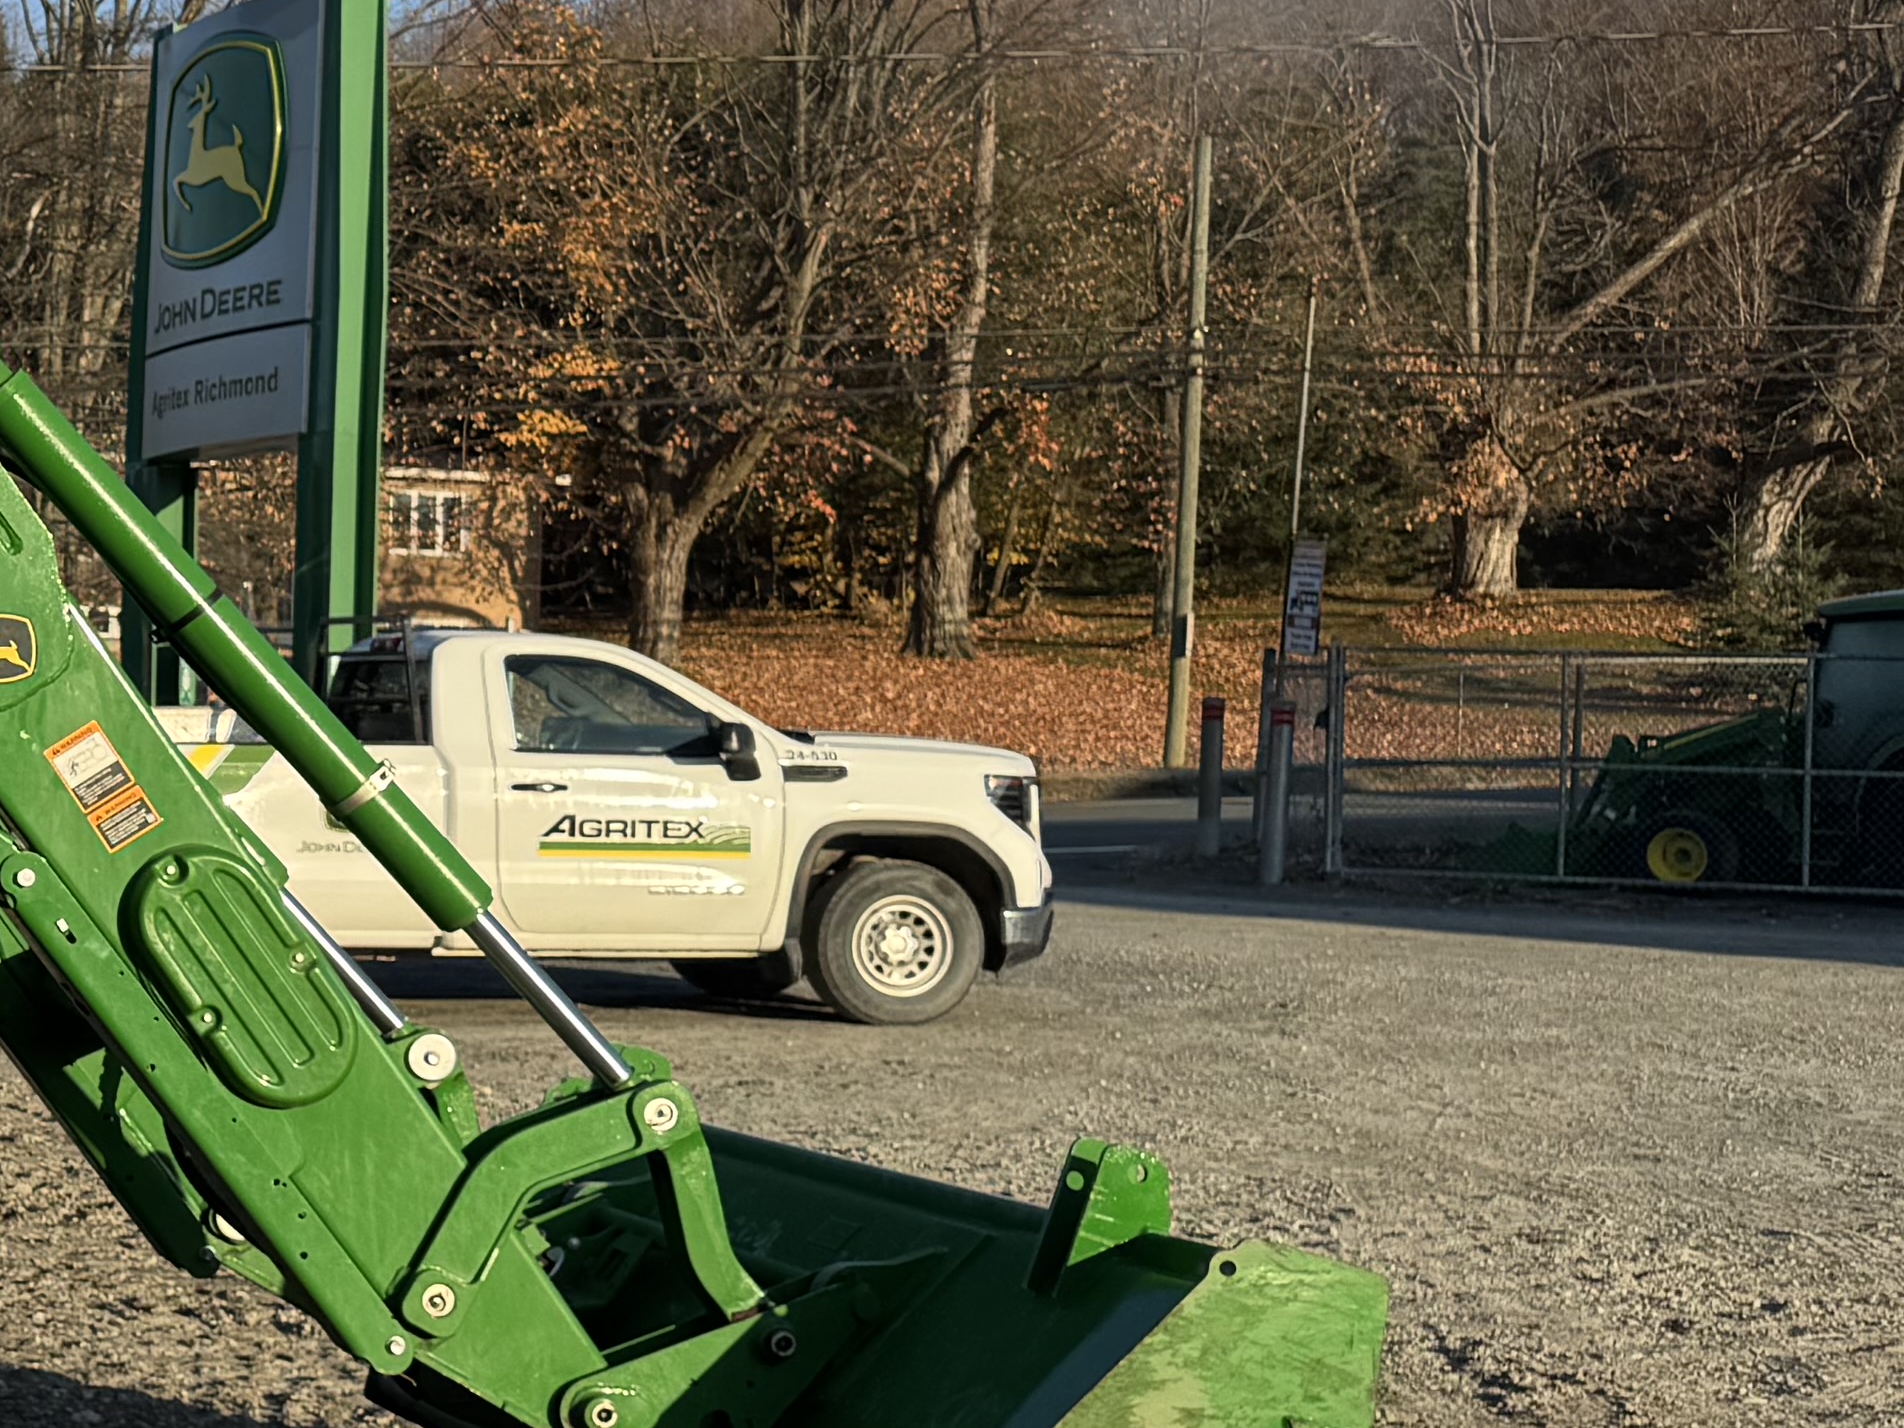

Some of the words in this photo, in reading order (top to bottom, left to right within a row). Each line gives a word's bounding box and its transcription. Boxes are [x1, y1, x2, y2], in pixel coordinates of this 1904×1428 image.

[154, 297, 197, 335] JOHN
[200, 279, 283, 320] DEERE
[152, 385, 190, 420] Agritex
[194, 366, 279, 405] Richmond
[541, 814, 706, 839] AGRITEX
